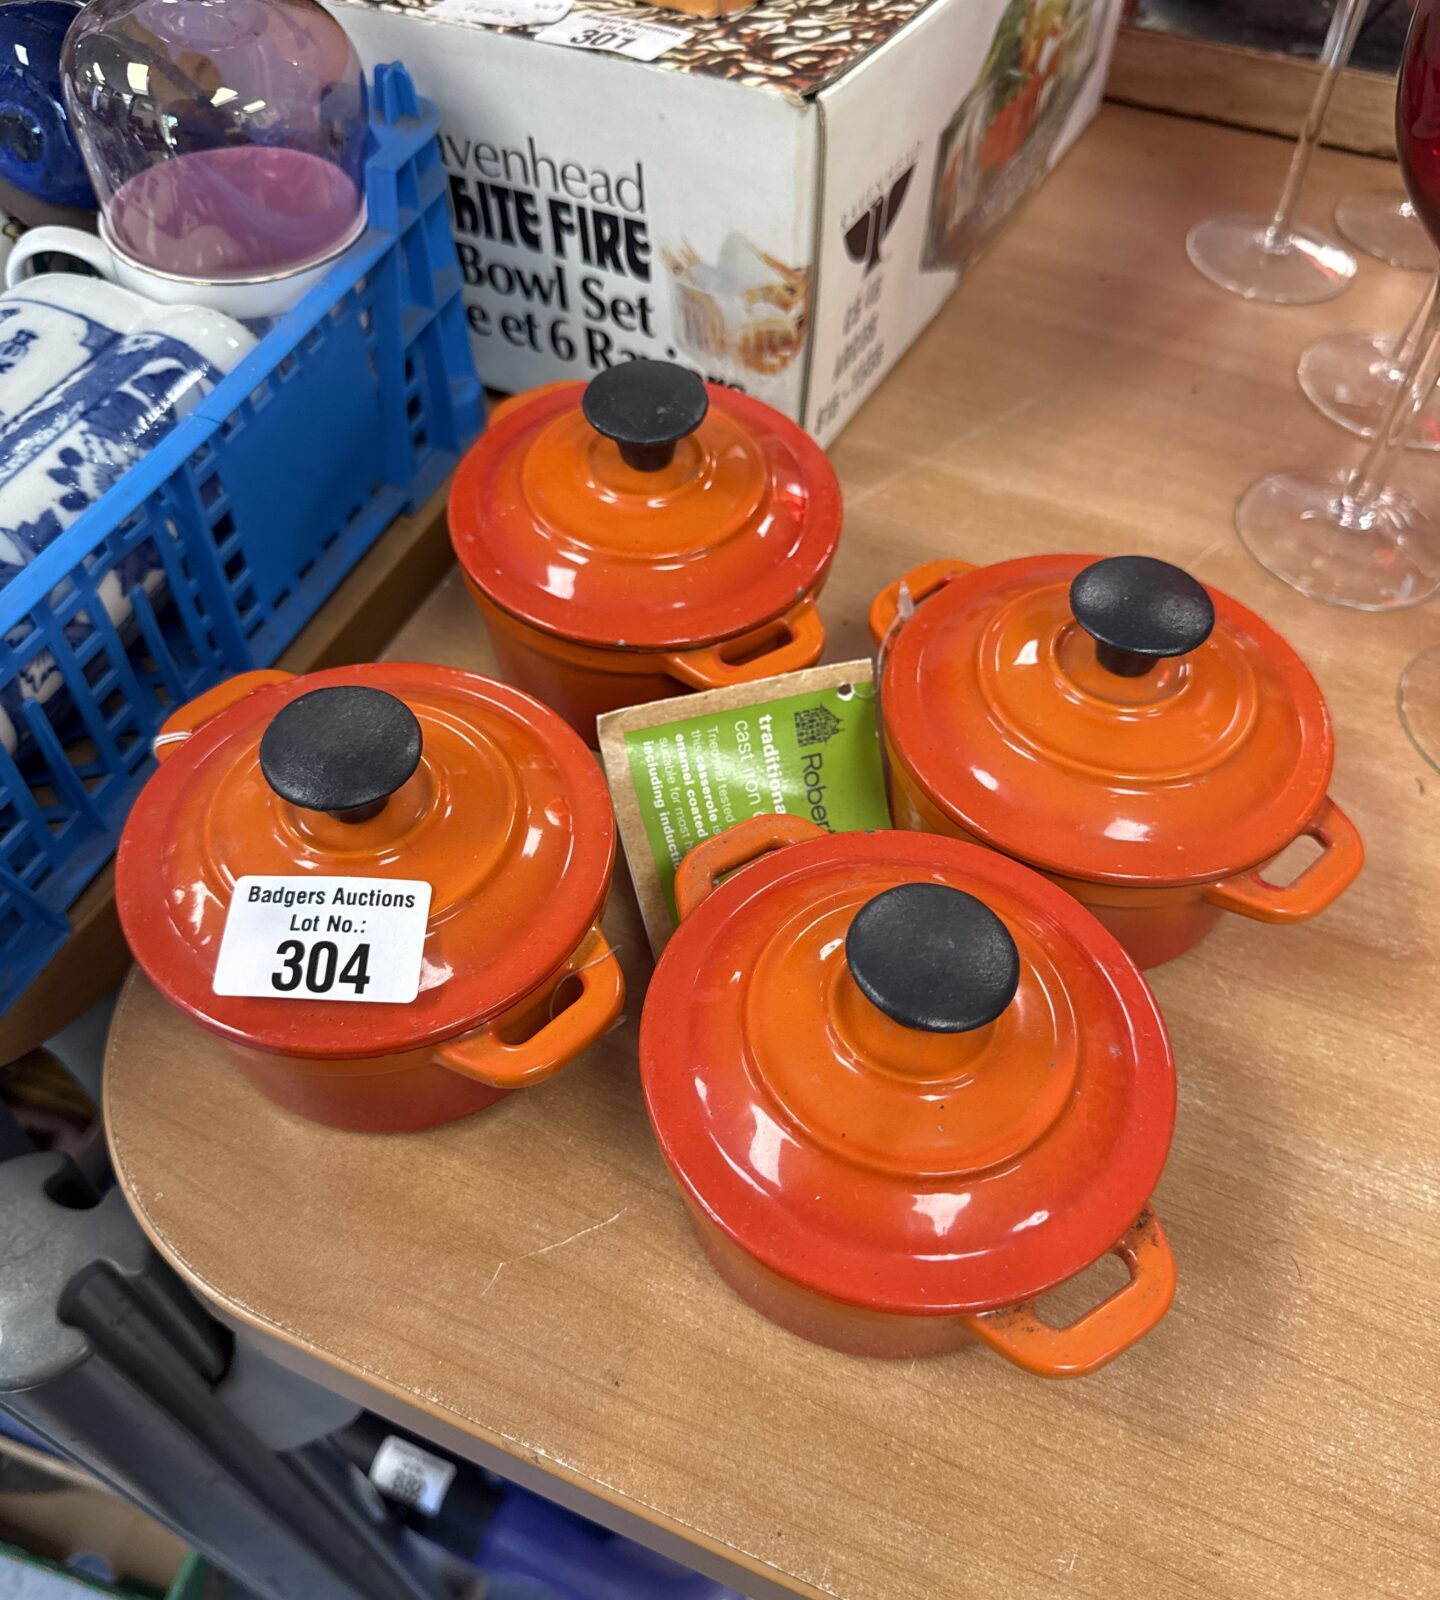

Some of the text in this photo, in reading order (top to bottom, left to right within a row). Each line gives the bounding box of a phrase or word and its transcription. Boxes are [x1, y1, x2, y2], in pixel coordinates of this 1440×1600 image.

[570, 29, 637, 49] 301
[548, 198, 652, 283] FIRE
[456, 242, 654, 338] Bowl Set
[500, 304, 544, 353] et
[550, 314, 576, 366] 6
[659, 737, 676, 784] suitable
[691, 729, 703, 752] this
[735, 720, 755, 762] cast
[675, 733, 695, 786] enamel
[686, 789, 709, 838] coated
[741, 766, 762, 805] iron
[758, 714, 787, 815] traditiona
[643, 740, 682, 870] including inductio
[670, 787, 681, 804] for
[696, 754, 719, 822] casserole
[719, 784, 736, 823] tested
[675, 807, 691, 838] most
[248, 885, 416, 908] Badgers Auctions
[289, 914, 367, 933] Lot No.:
[271, 939, 371, 994] 304
